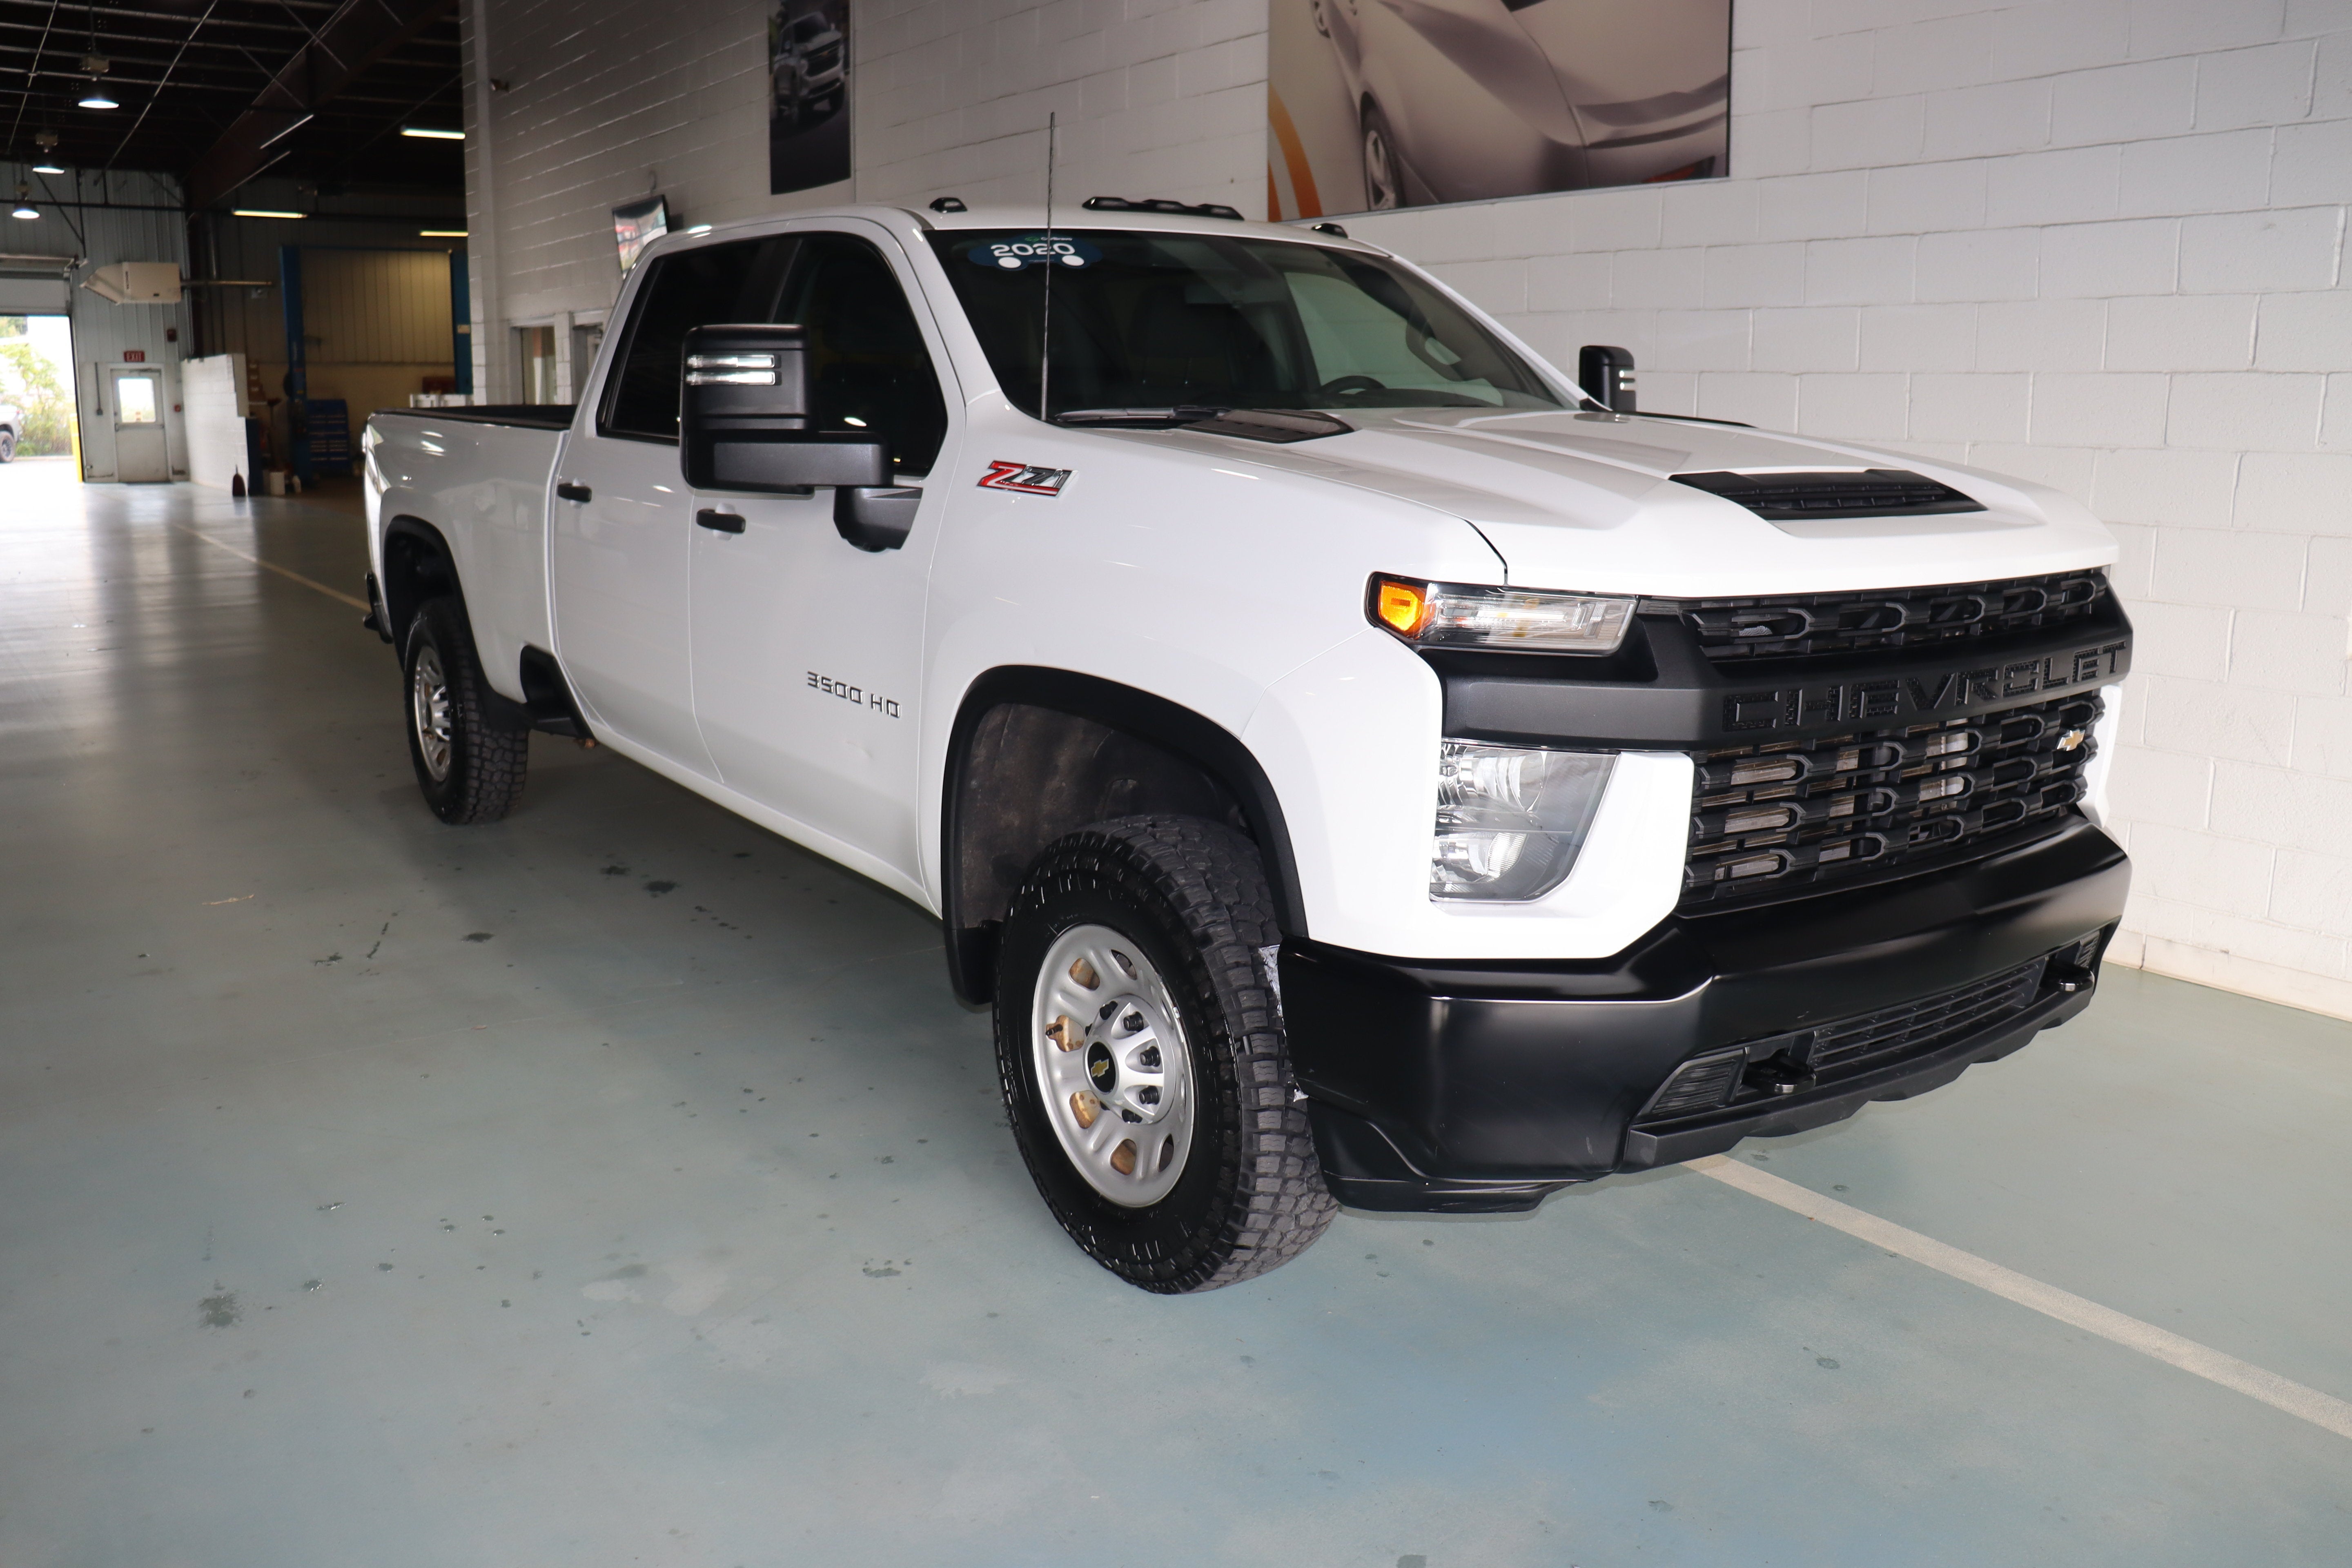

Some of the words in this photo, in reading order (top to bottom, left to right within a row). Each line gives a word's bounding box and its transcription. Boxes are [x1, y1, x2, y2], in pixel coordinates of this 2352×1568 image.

[991, 243, 1075, 256] 2020
[127, 352, 141, 361] EXIT
[976, 460, 1078, 499] Z71
[807, 671, 864, 704] 3500
[871, 693, 901, 718] HD
[1722, 640, 2127, 731] CHEVROLET
